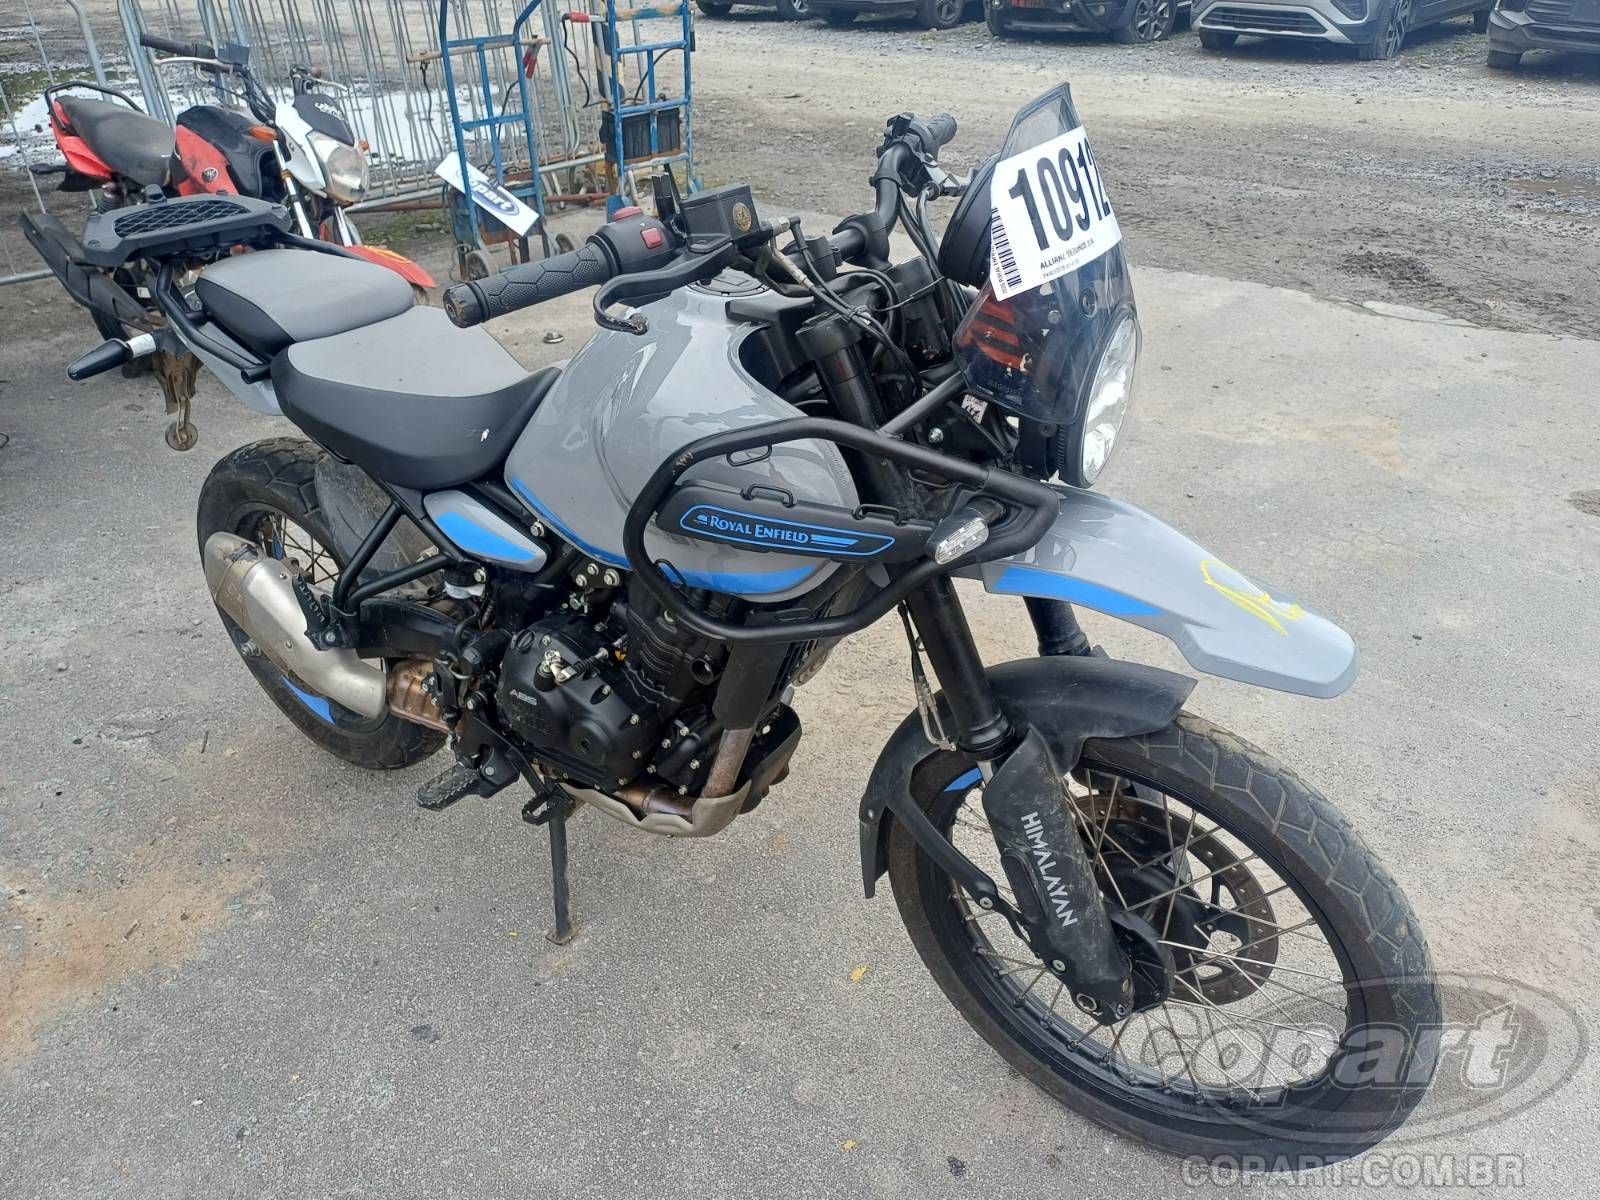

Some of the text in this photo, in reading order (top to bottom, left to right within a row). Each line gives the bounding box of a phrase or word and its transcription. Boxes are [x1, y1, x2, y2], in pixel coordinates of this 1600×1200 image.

[456, 169, 515, 211] opart
[709, 515, 809, 544] ROYAL ENFIELD
[1020, 811, 1079, 927] HIMALAYAN
